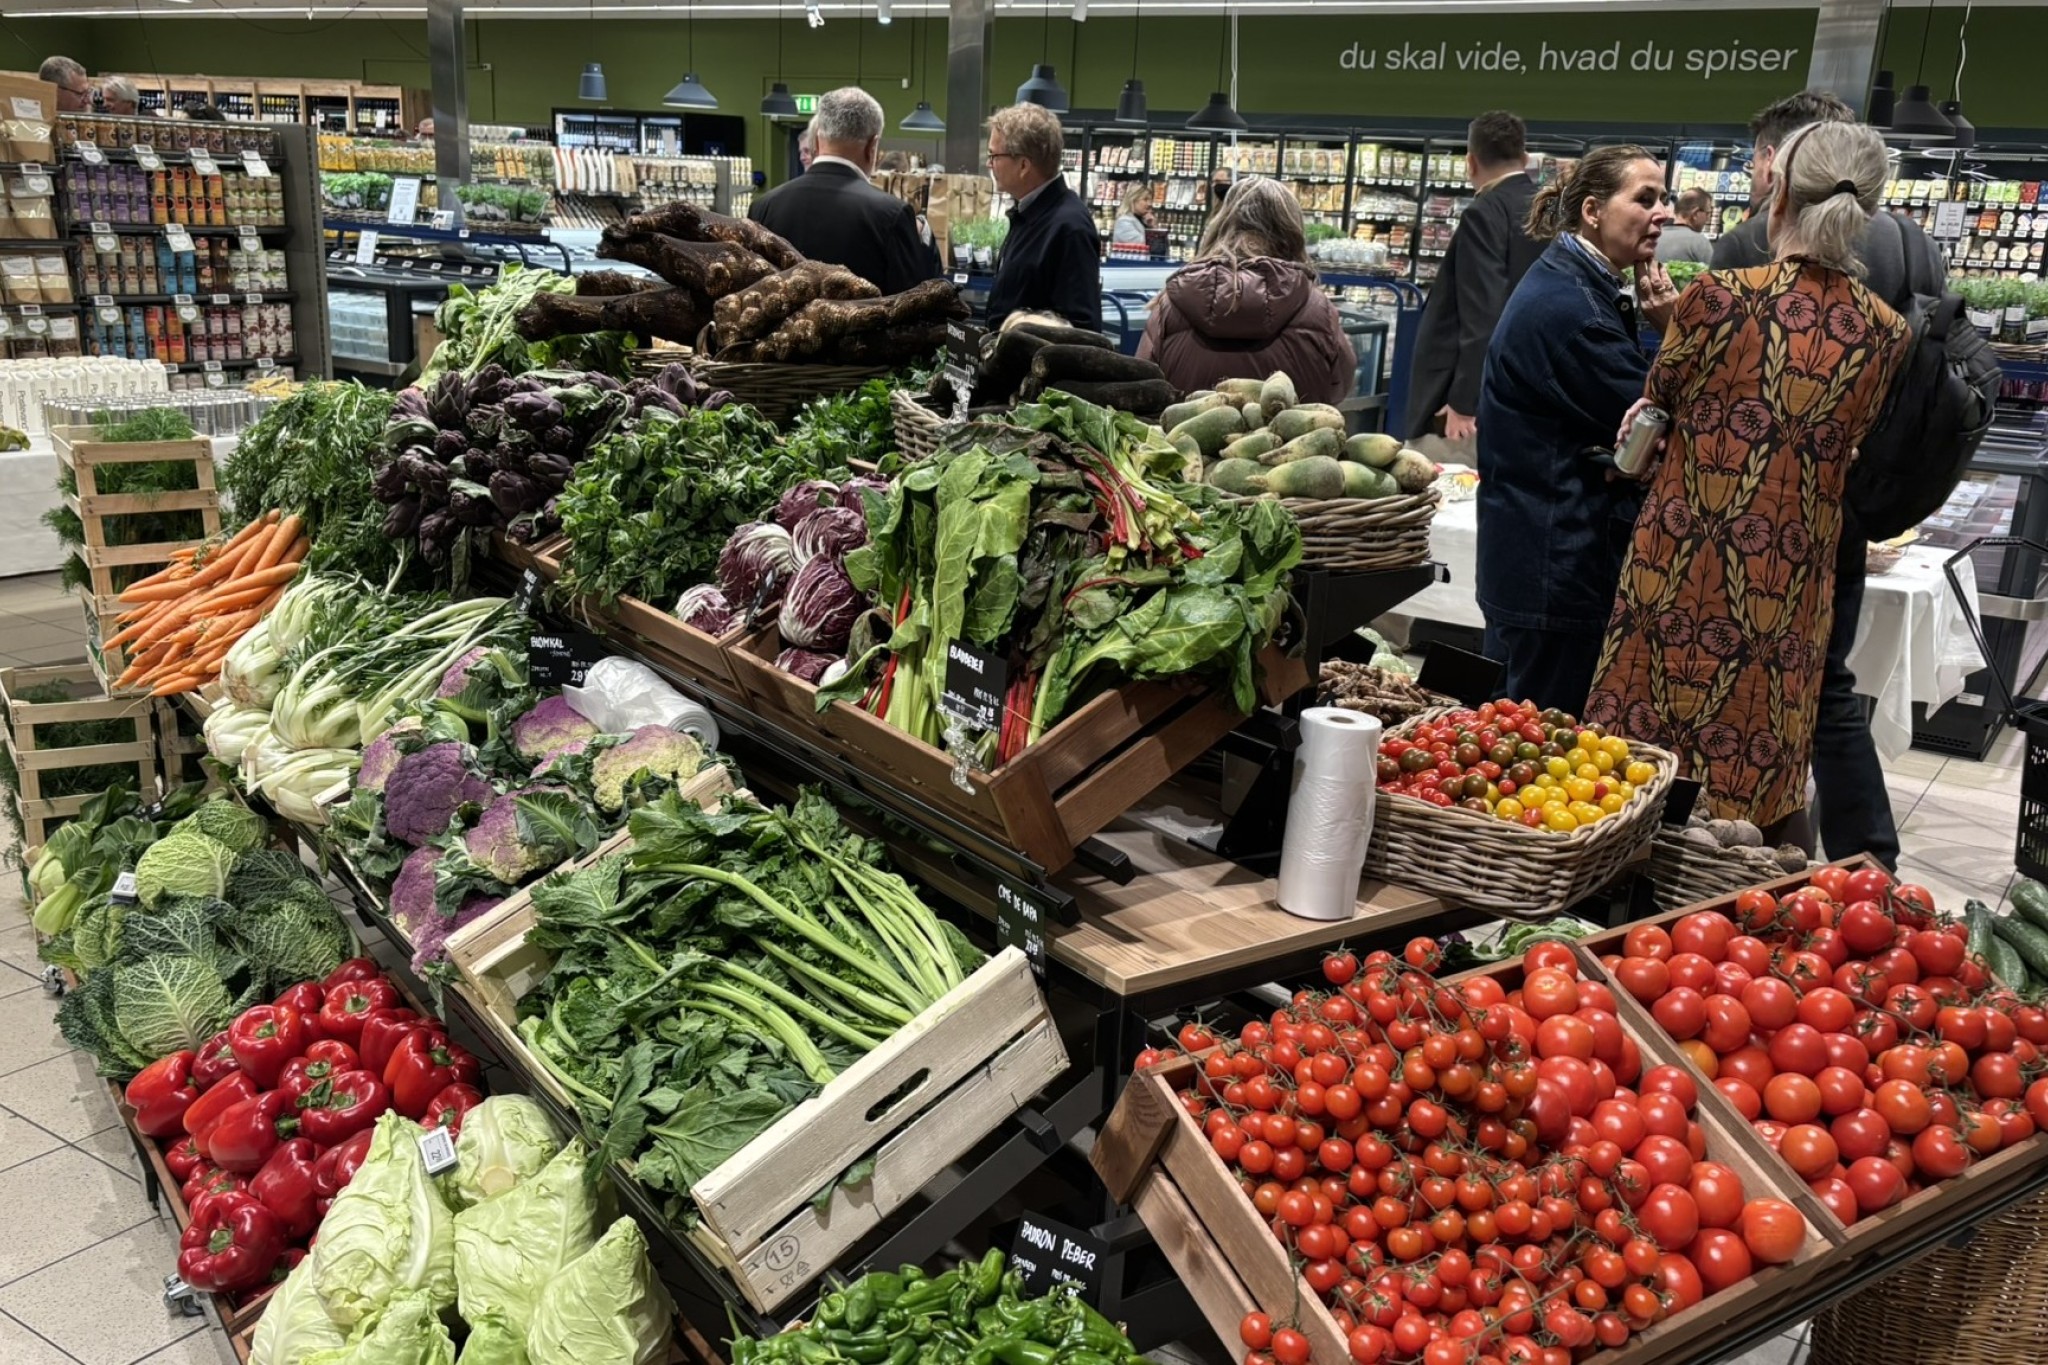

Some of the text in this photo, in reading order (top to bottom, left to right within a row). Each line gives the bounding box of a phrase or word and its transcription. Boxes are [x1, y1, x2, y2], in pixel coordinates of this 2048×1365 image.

[1339, 39, 1798, 79] du skal vide, hvad du spiser
[1013, 893, 1022, 912] DE
[769, 1239, 794, 1265] 15
[1060, 1238, 1097, 1272] PEBER
